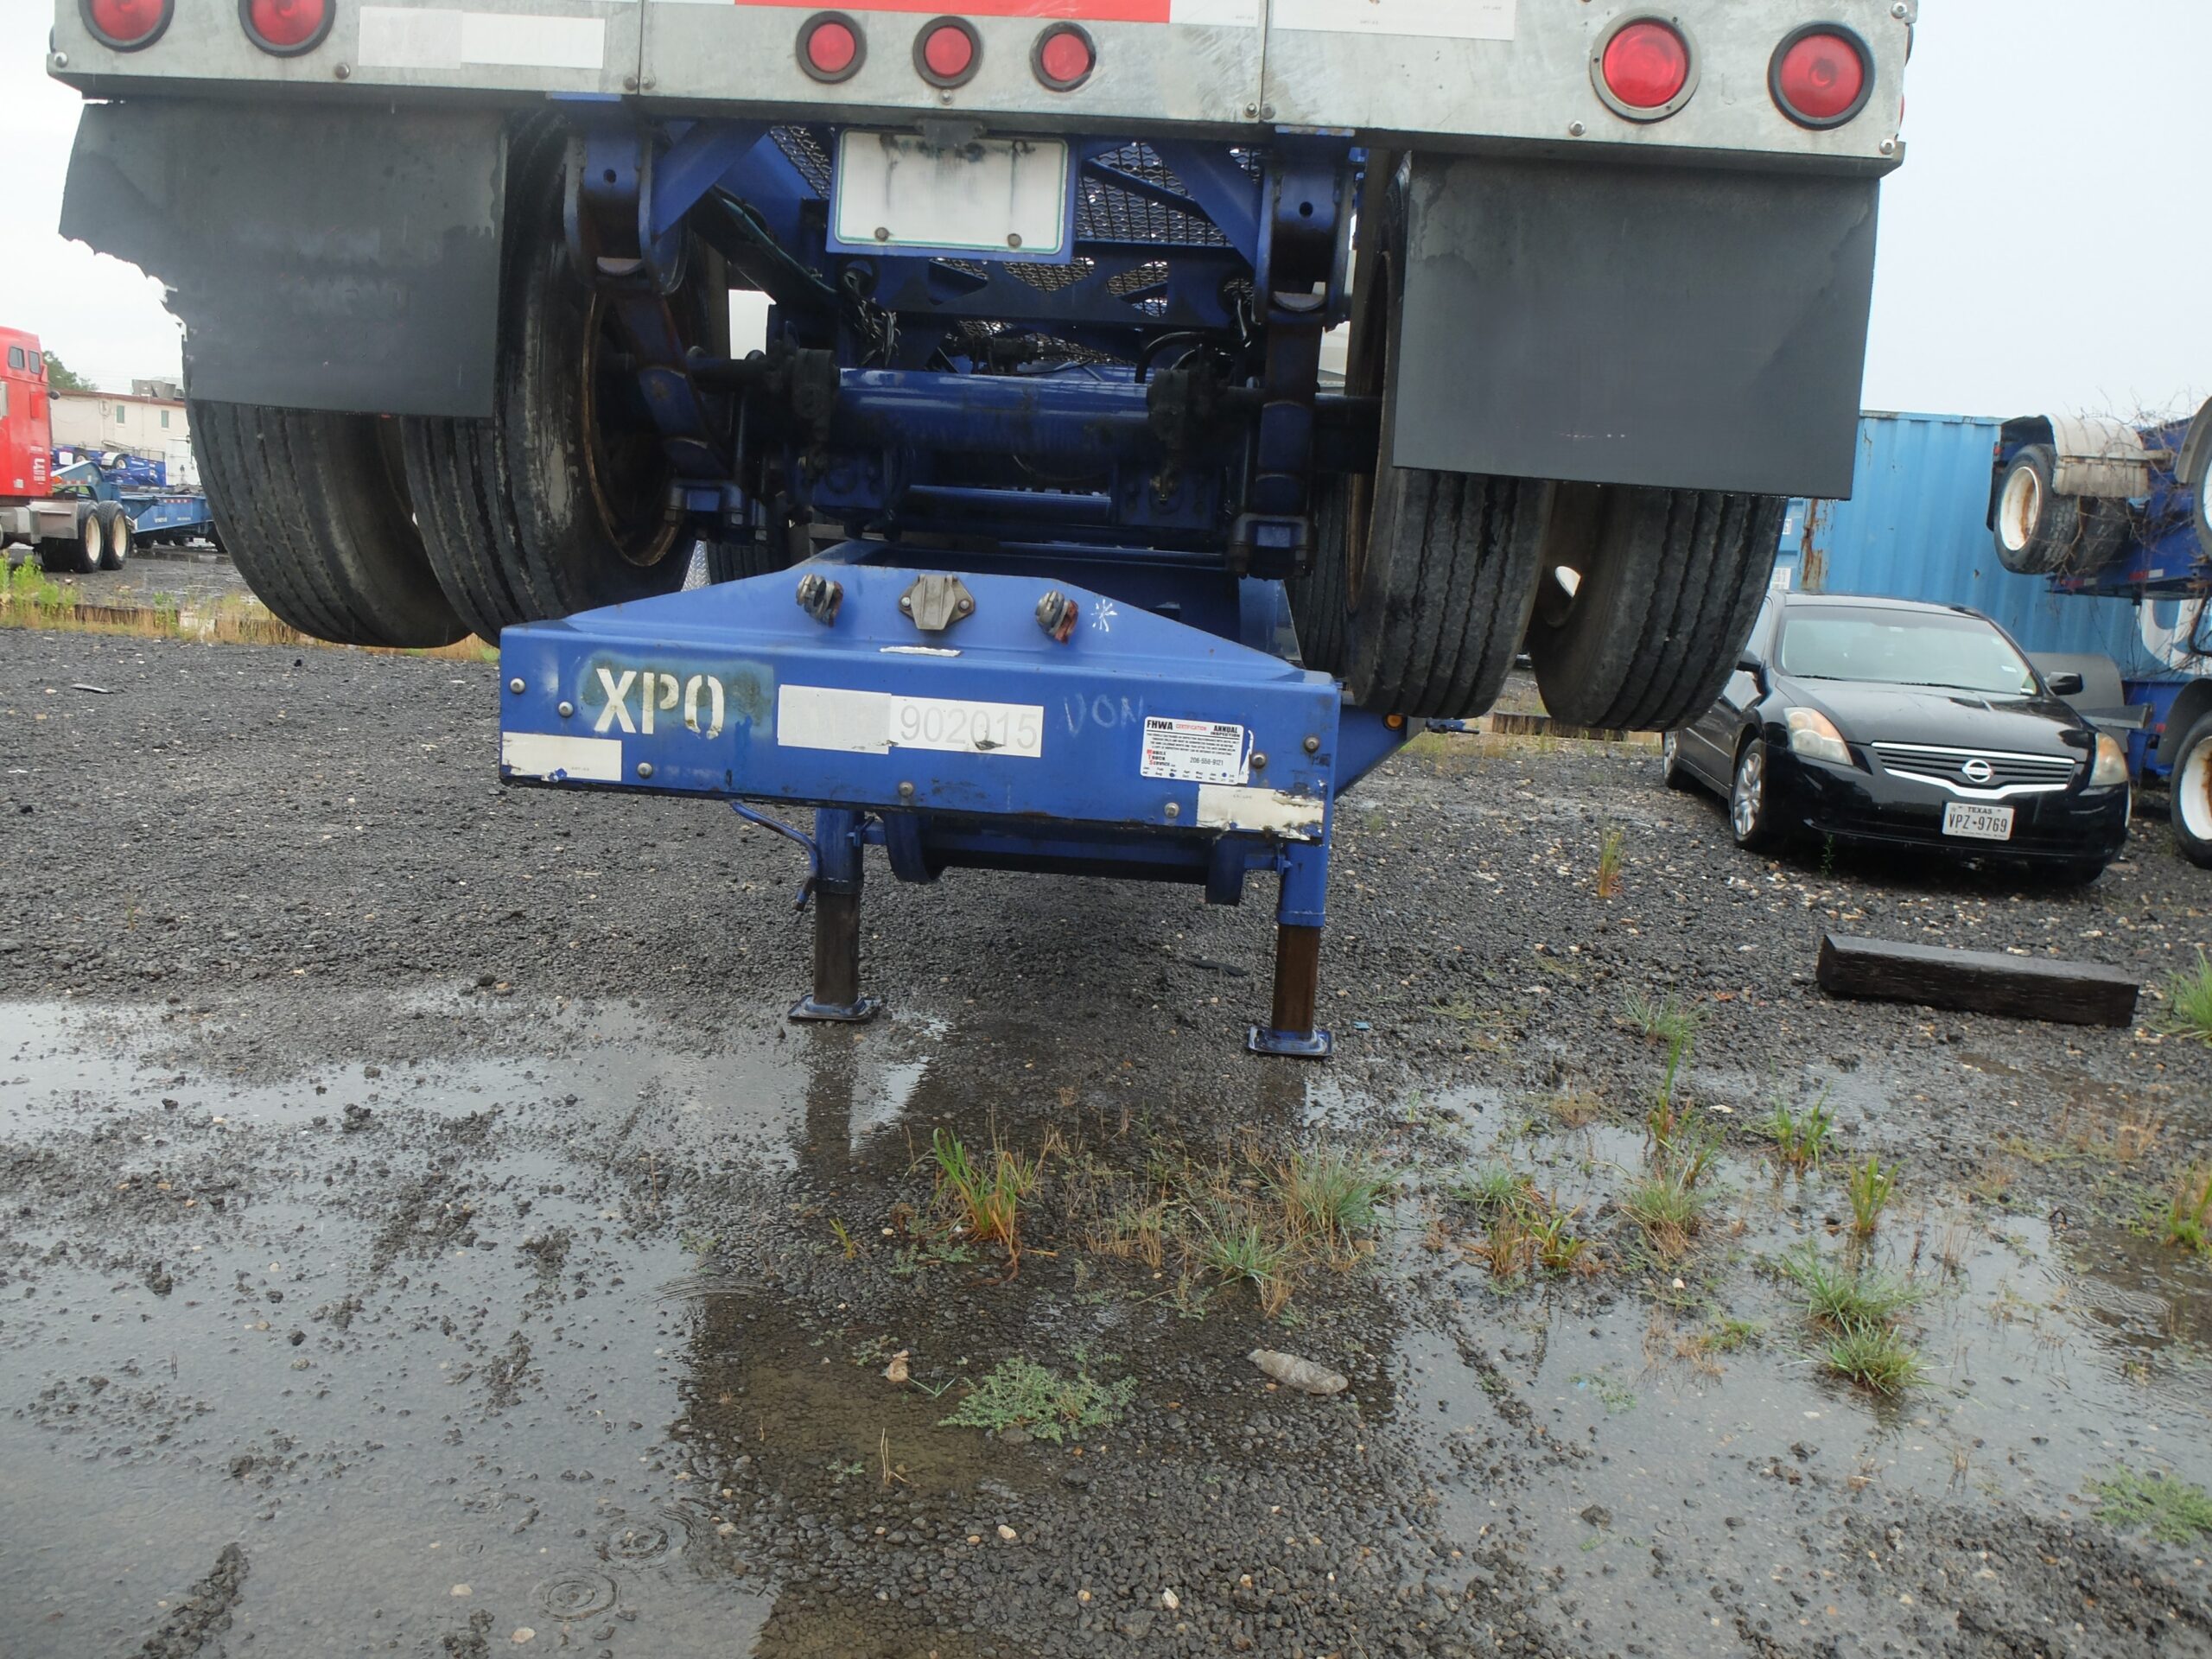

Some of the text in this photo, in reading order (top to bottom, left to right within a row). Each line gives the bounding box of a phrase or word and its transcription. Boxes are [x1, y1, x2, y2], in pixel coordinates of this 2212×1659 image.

[594, 668, 725, 740] XPO
[899, 704, 1038, 750] 902015
[1147, 720, 1173, 730] FHWA
[1213, 725, 1238, 734] ANNUAL
